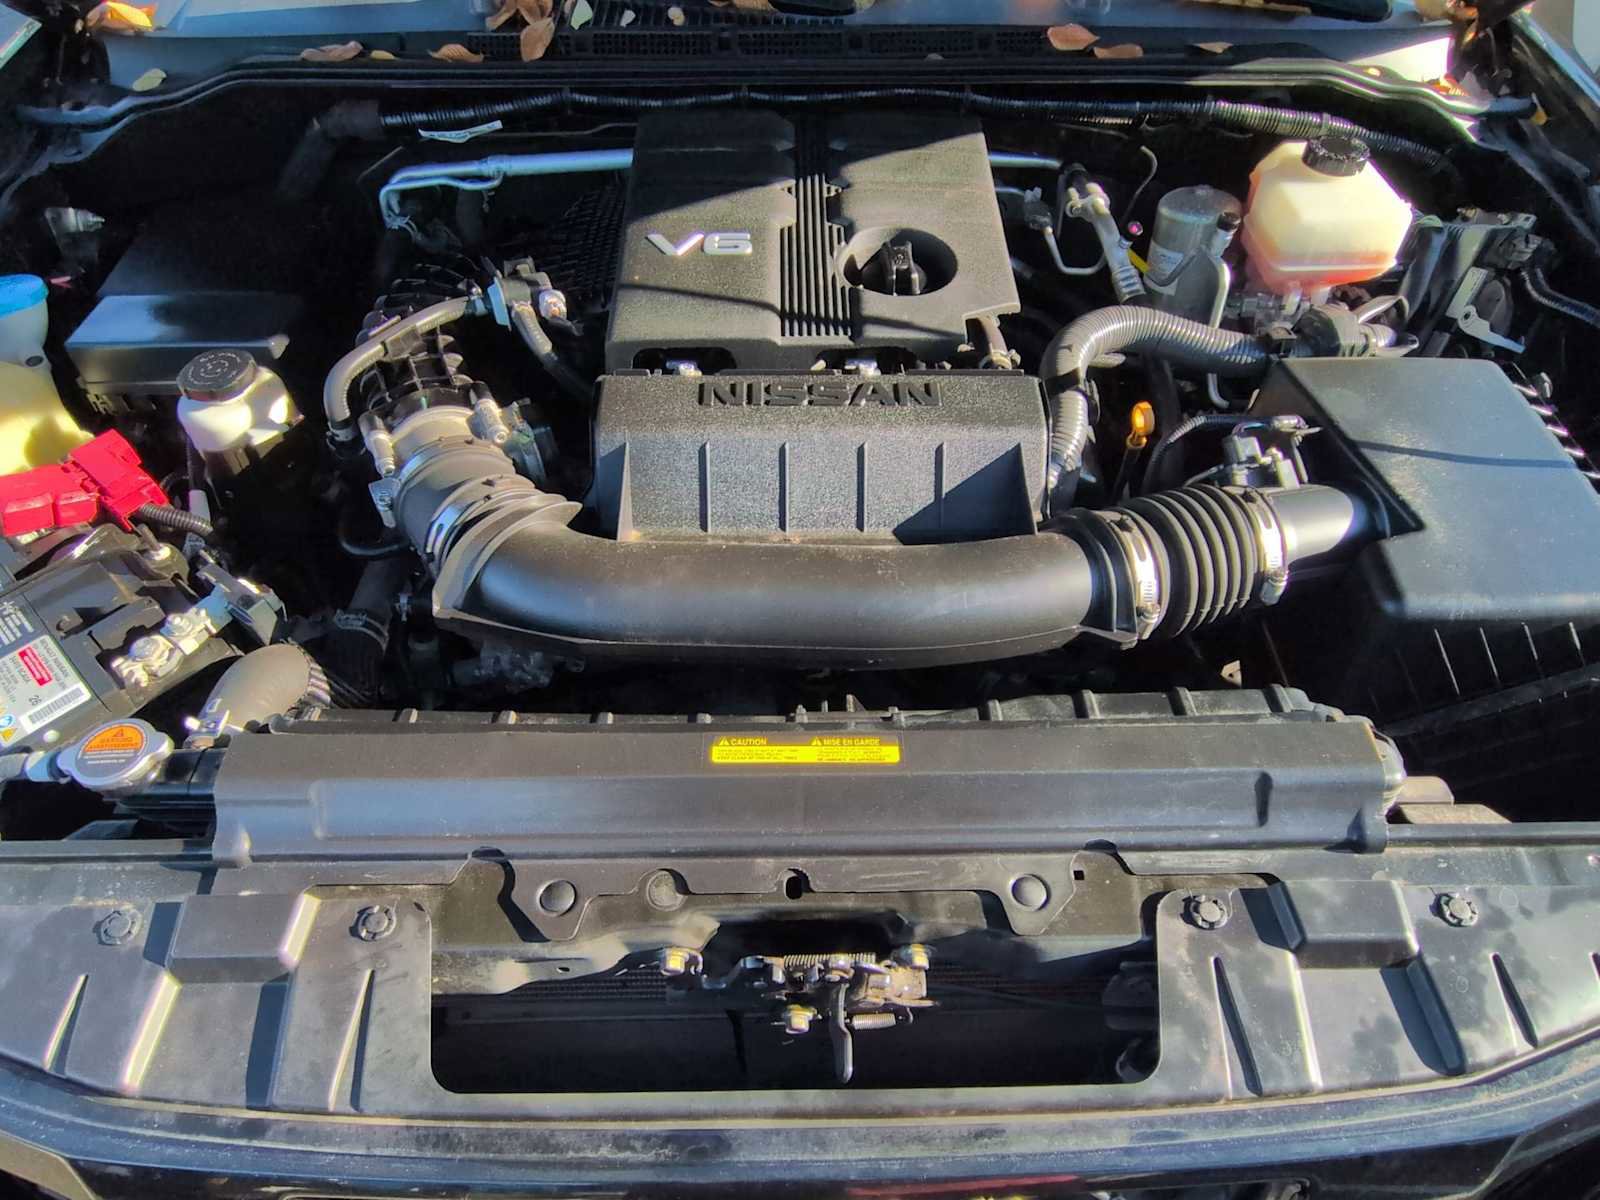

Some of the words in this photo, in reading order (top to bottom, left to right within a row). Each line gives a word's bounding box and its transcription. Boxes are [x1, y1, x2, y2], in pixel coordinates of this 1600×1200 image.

[645, 232, 753, 256] V6
[699, 382, 943, 407] NISSAN
[730, 737, 767, 746] CAUTION
